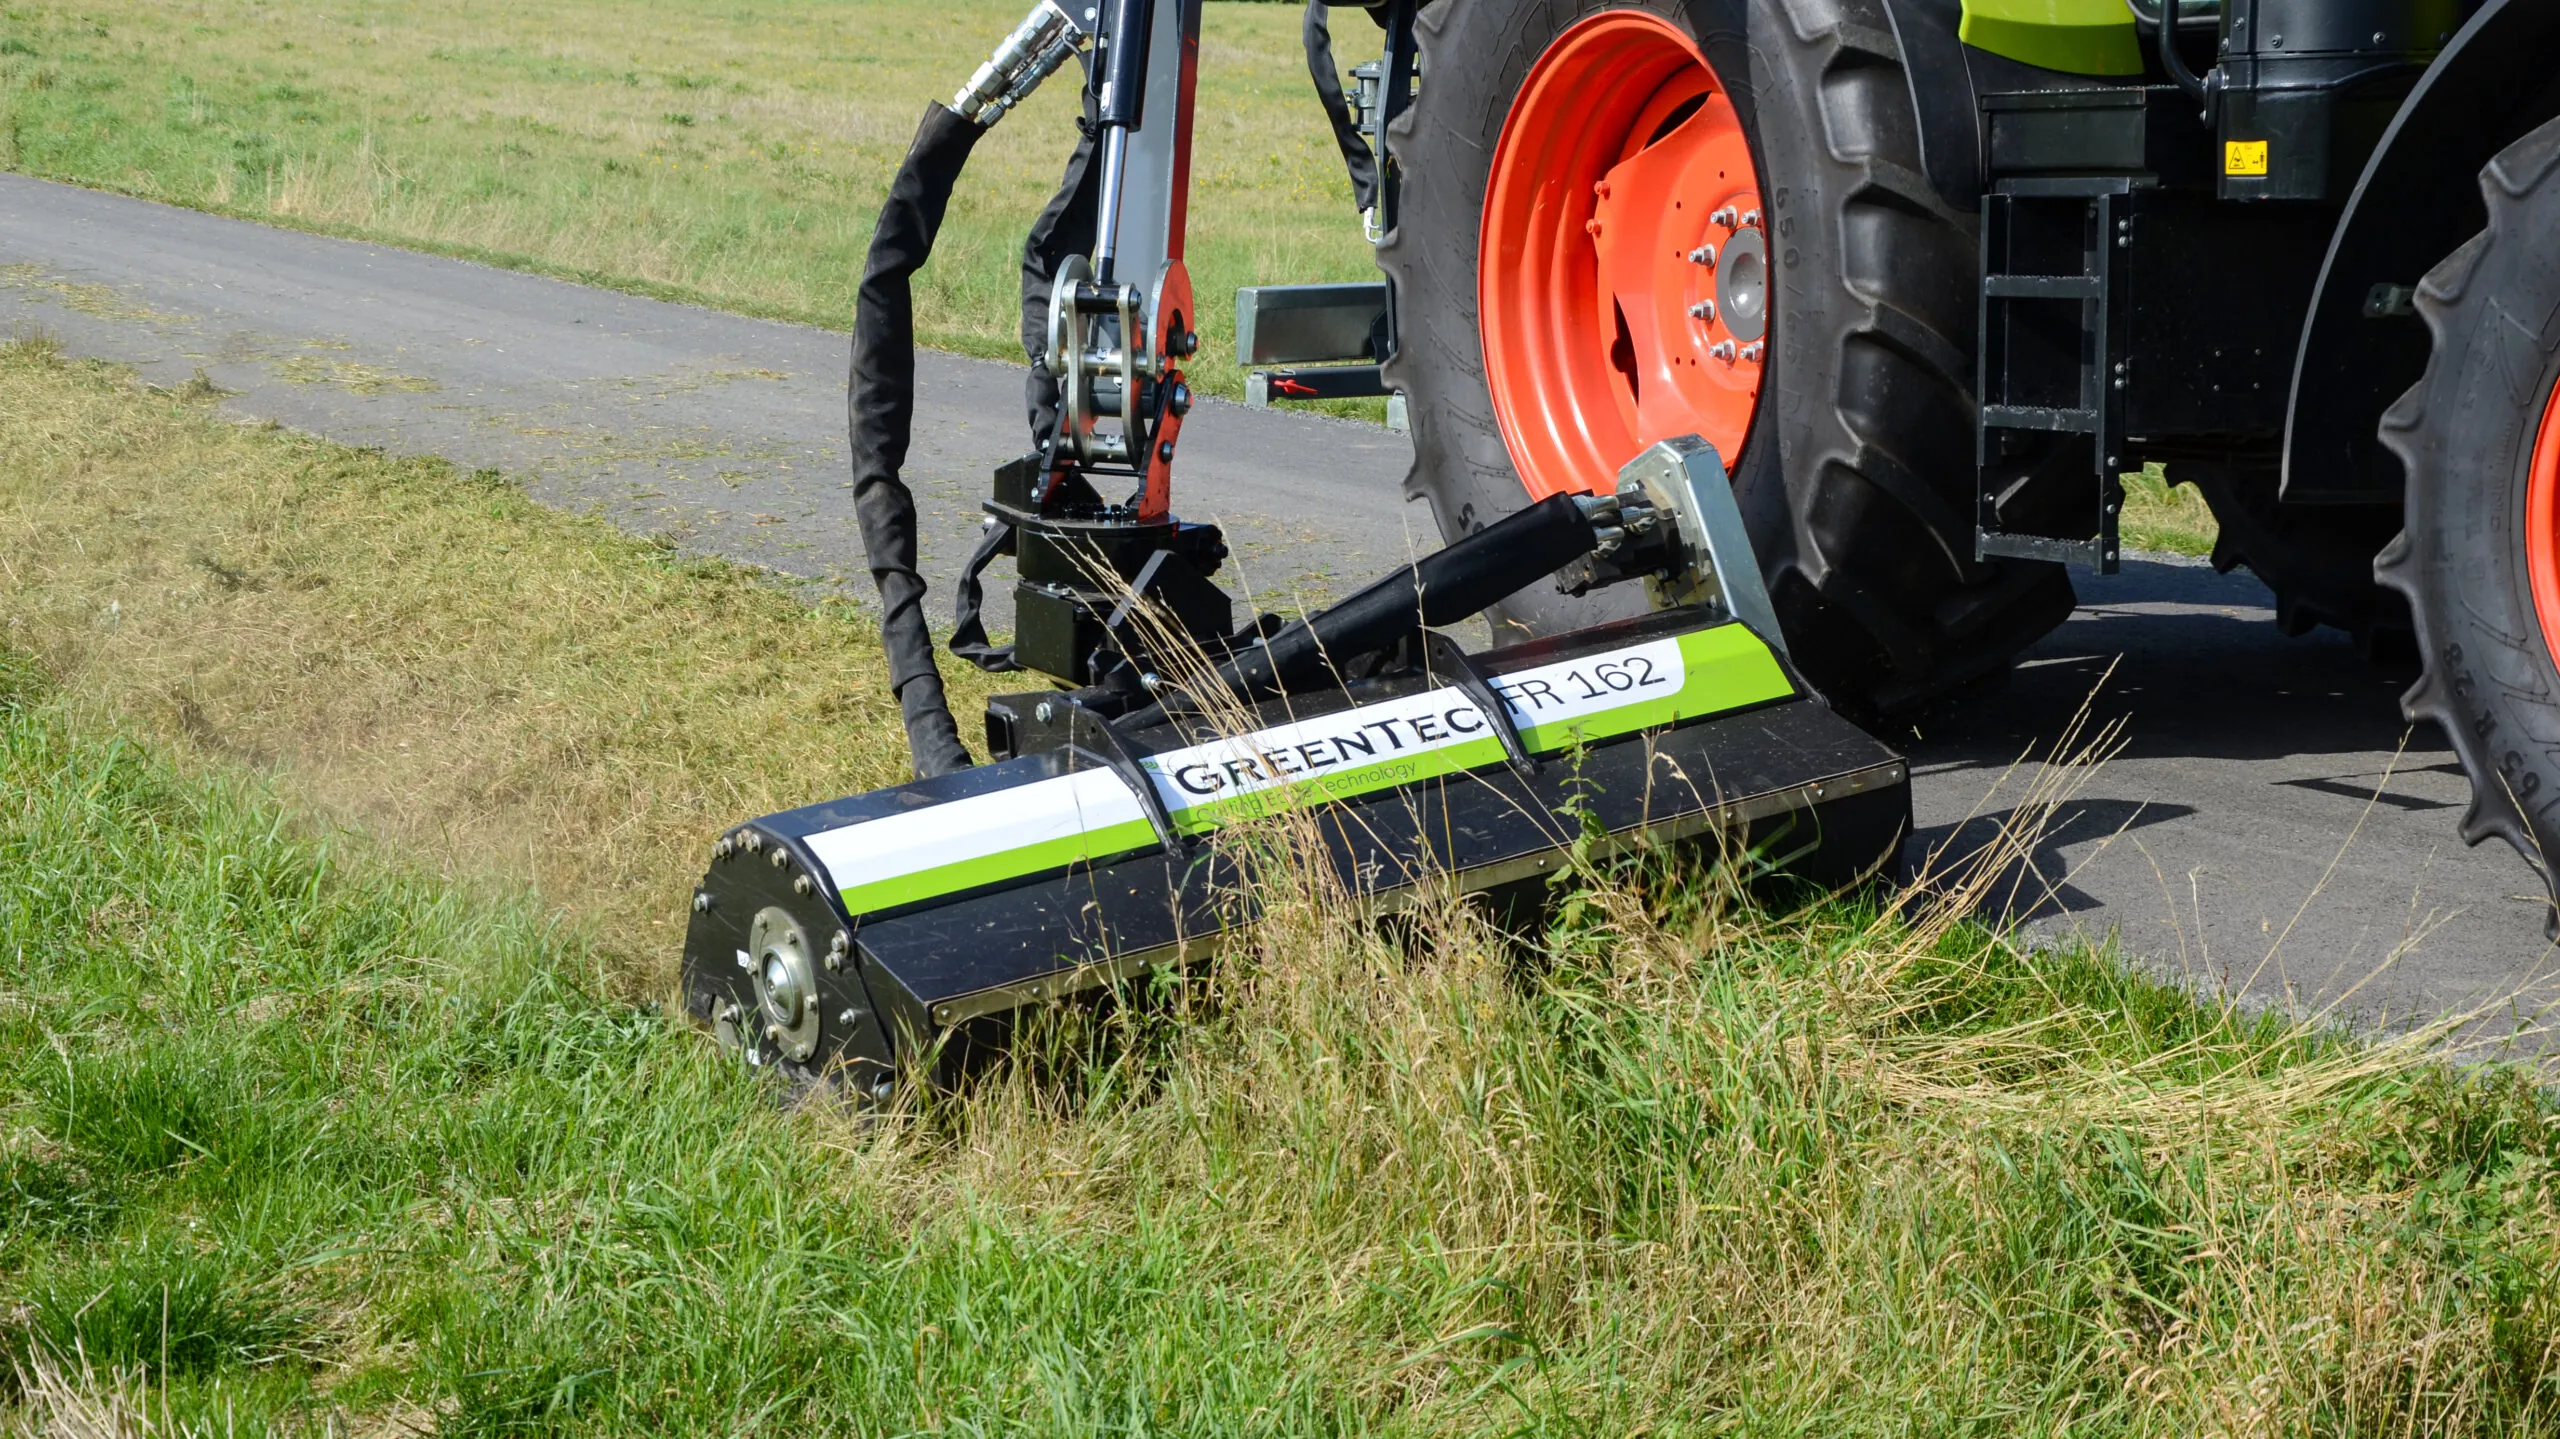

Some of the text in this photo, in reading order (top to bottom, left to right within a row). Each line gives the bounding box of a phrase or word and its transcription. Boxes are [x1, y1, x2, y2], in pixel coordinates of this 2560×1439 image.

[2443, 643, 2476, 697] 28
[1175, 657, 1666, 795] GREENTEC FR 162
[2474, 708, 2499, 741] R
